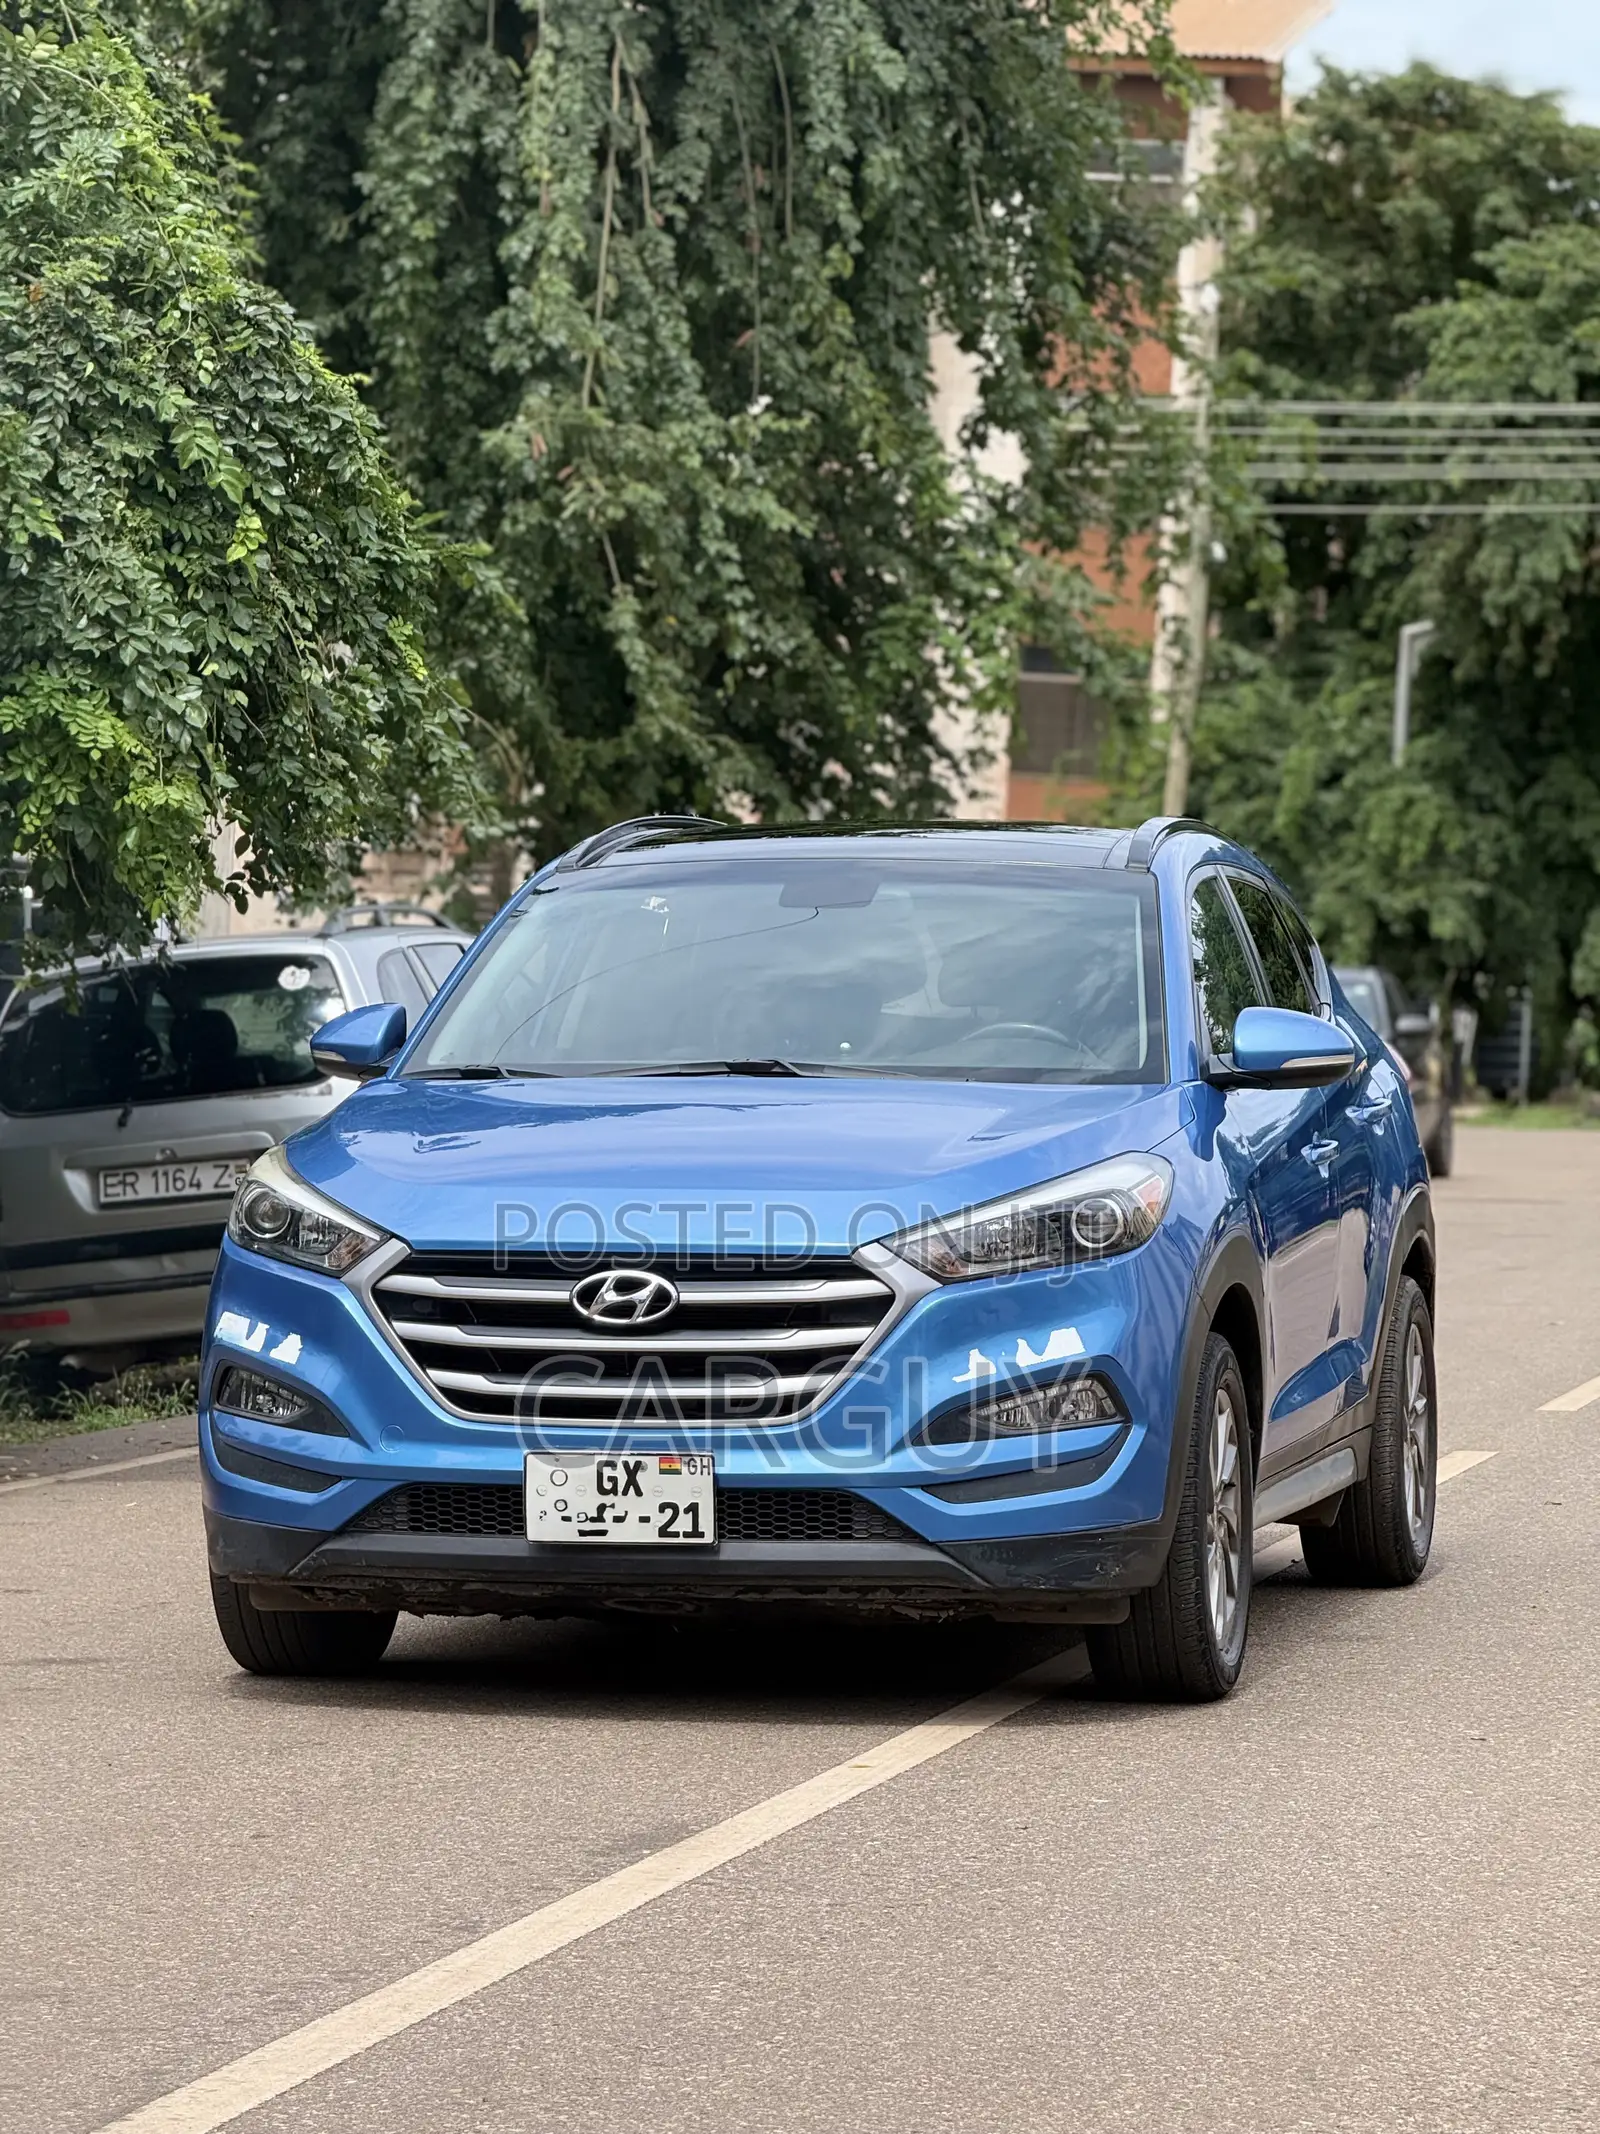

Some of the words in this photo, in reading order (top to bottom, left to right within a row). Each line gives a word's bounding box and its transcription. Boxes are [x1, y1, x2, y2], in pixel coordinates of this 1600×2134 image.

[103, 1172, 139, 1198] ER
[152, 1166, 203, 1193] 1164
[213, 1164, 231, 1188] Z
[596, 1460, 644, 1497] GX
[687, 1458, 711, 1476] GH
